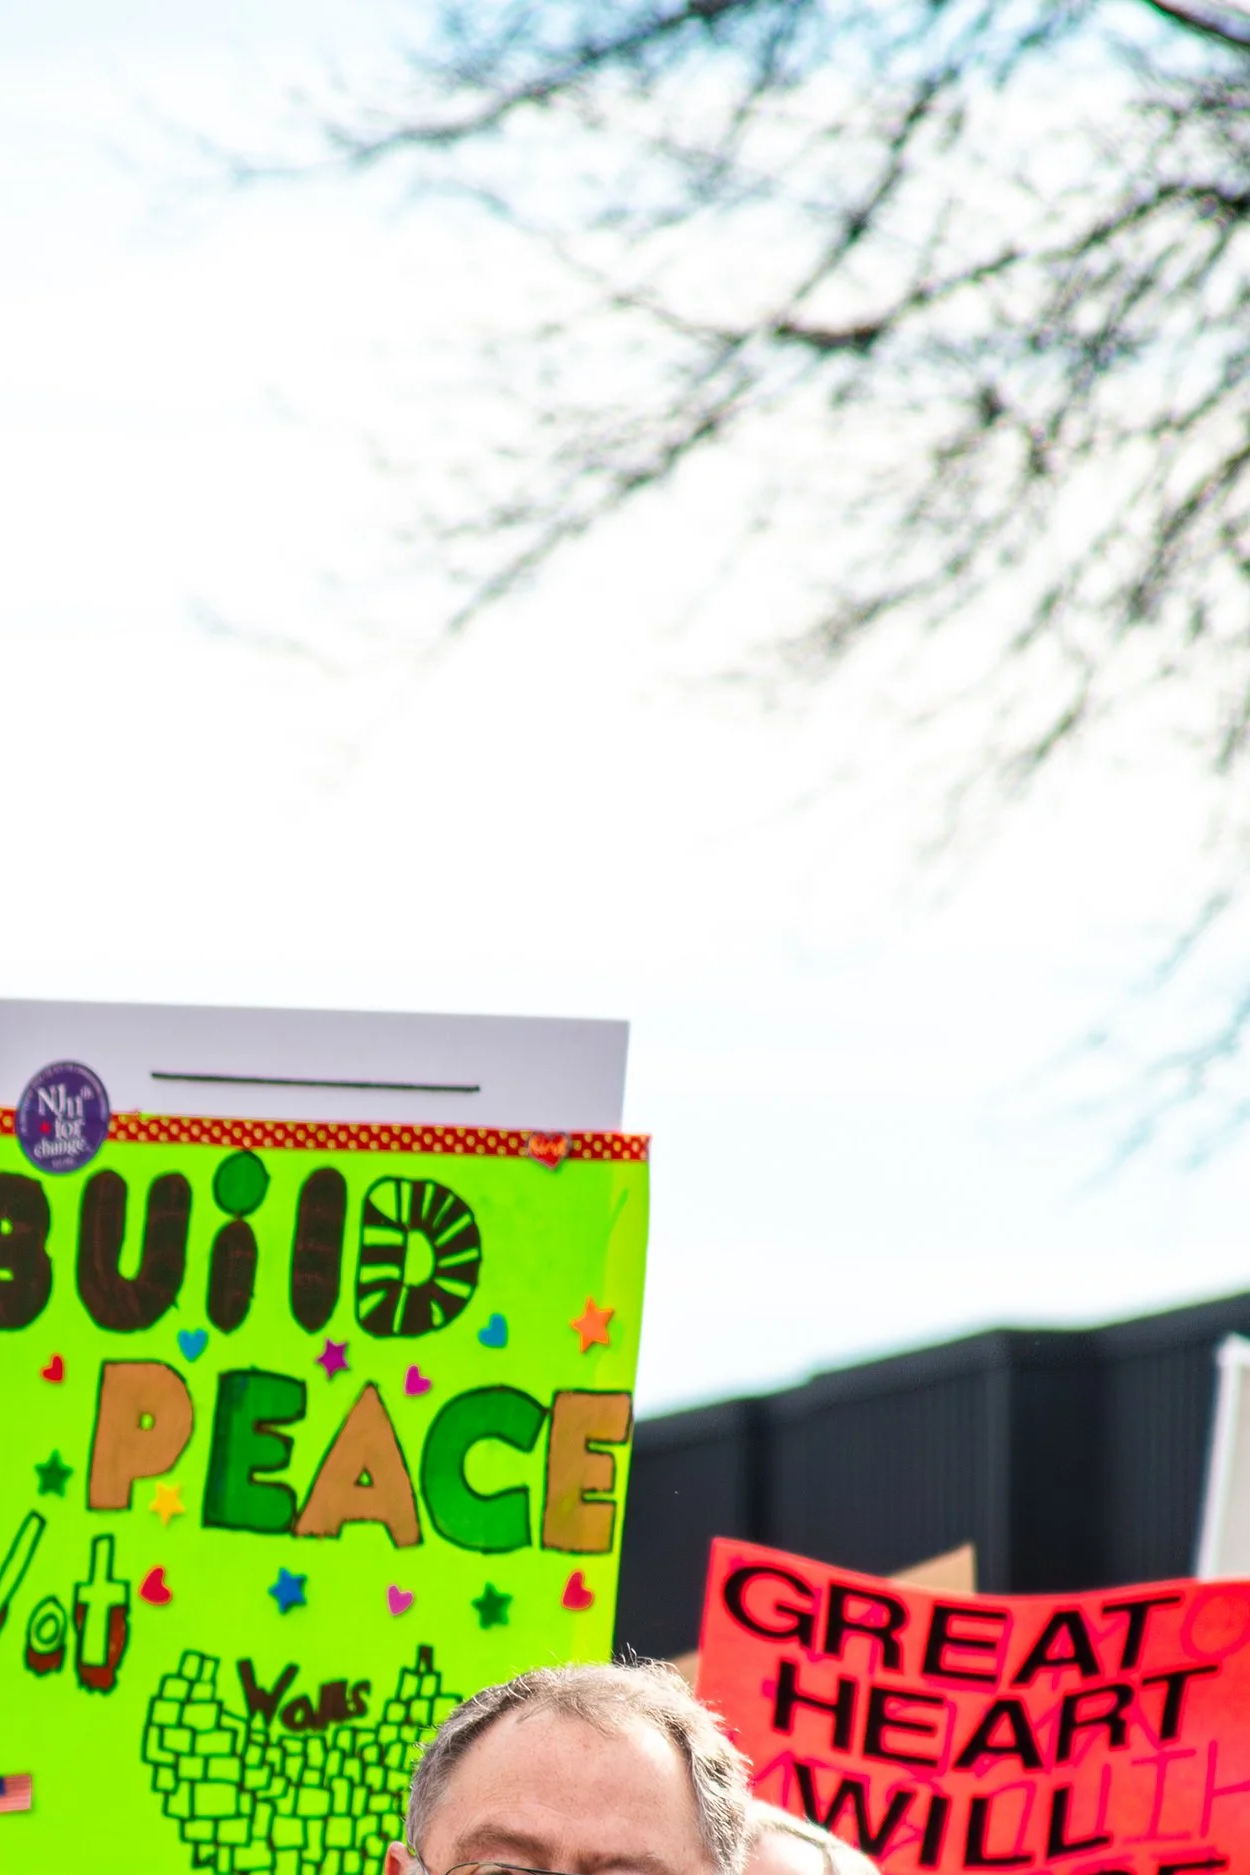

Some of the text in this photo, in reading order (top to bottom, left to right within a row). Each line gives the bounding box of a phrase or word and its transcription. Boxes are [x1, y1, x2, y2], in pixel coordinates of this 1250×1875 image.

[86, 1358, 634, 1553] PEACE
[723, 1566, 1182, 1686] GREAT
[772, 1663, 1219, 1771] HEART
[794, 1763, 1110, 1868] WILL
